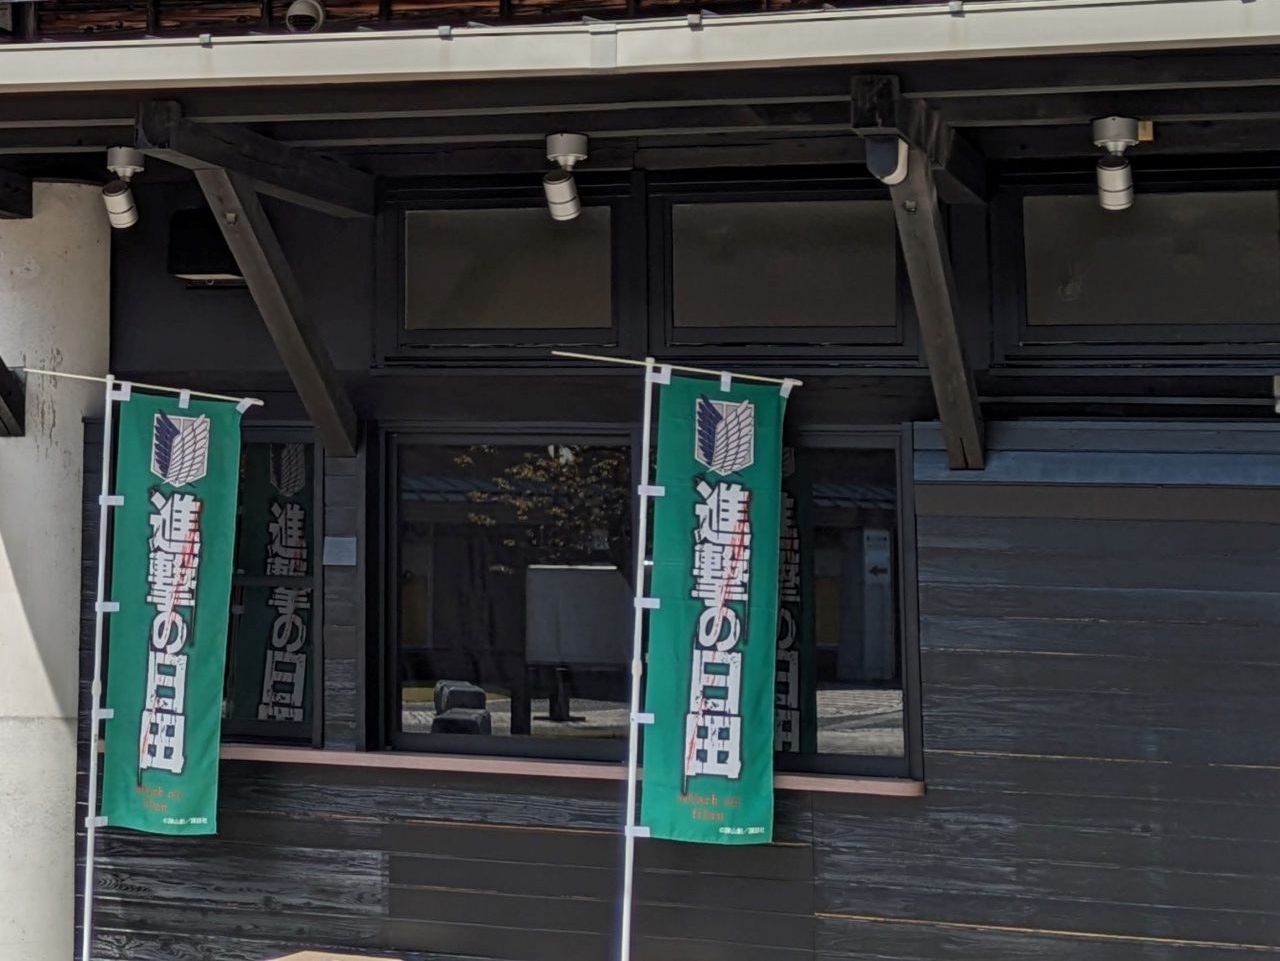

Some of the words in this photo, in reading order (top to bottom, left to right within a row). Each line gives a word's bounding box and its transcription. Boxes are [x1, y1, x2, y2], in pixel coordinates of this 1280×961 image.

[140, 492, 201, 774] 進撃の日田
[685, 481, 752, 779] 進撃の日田
